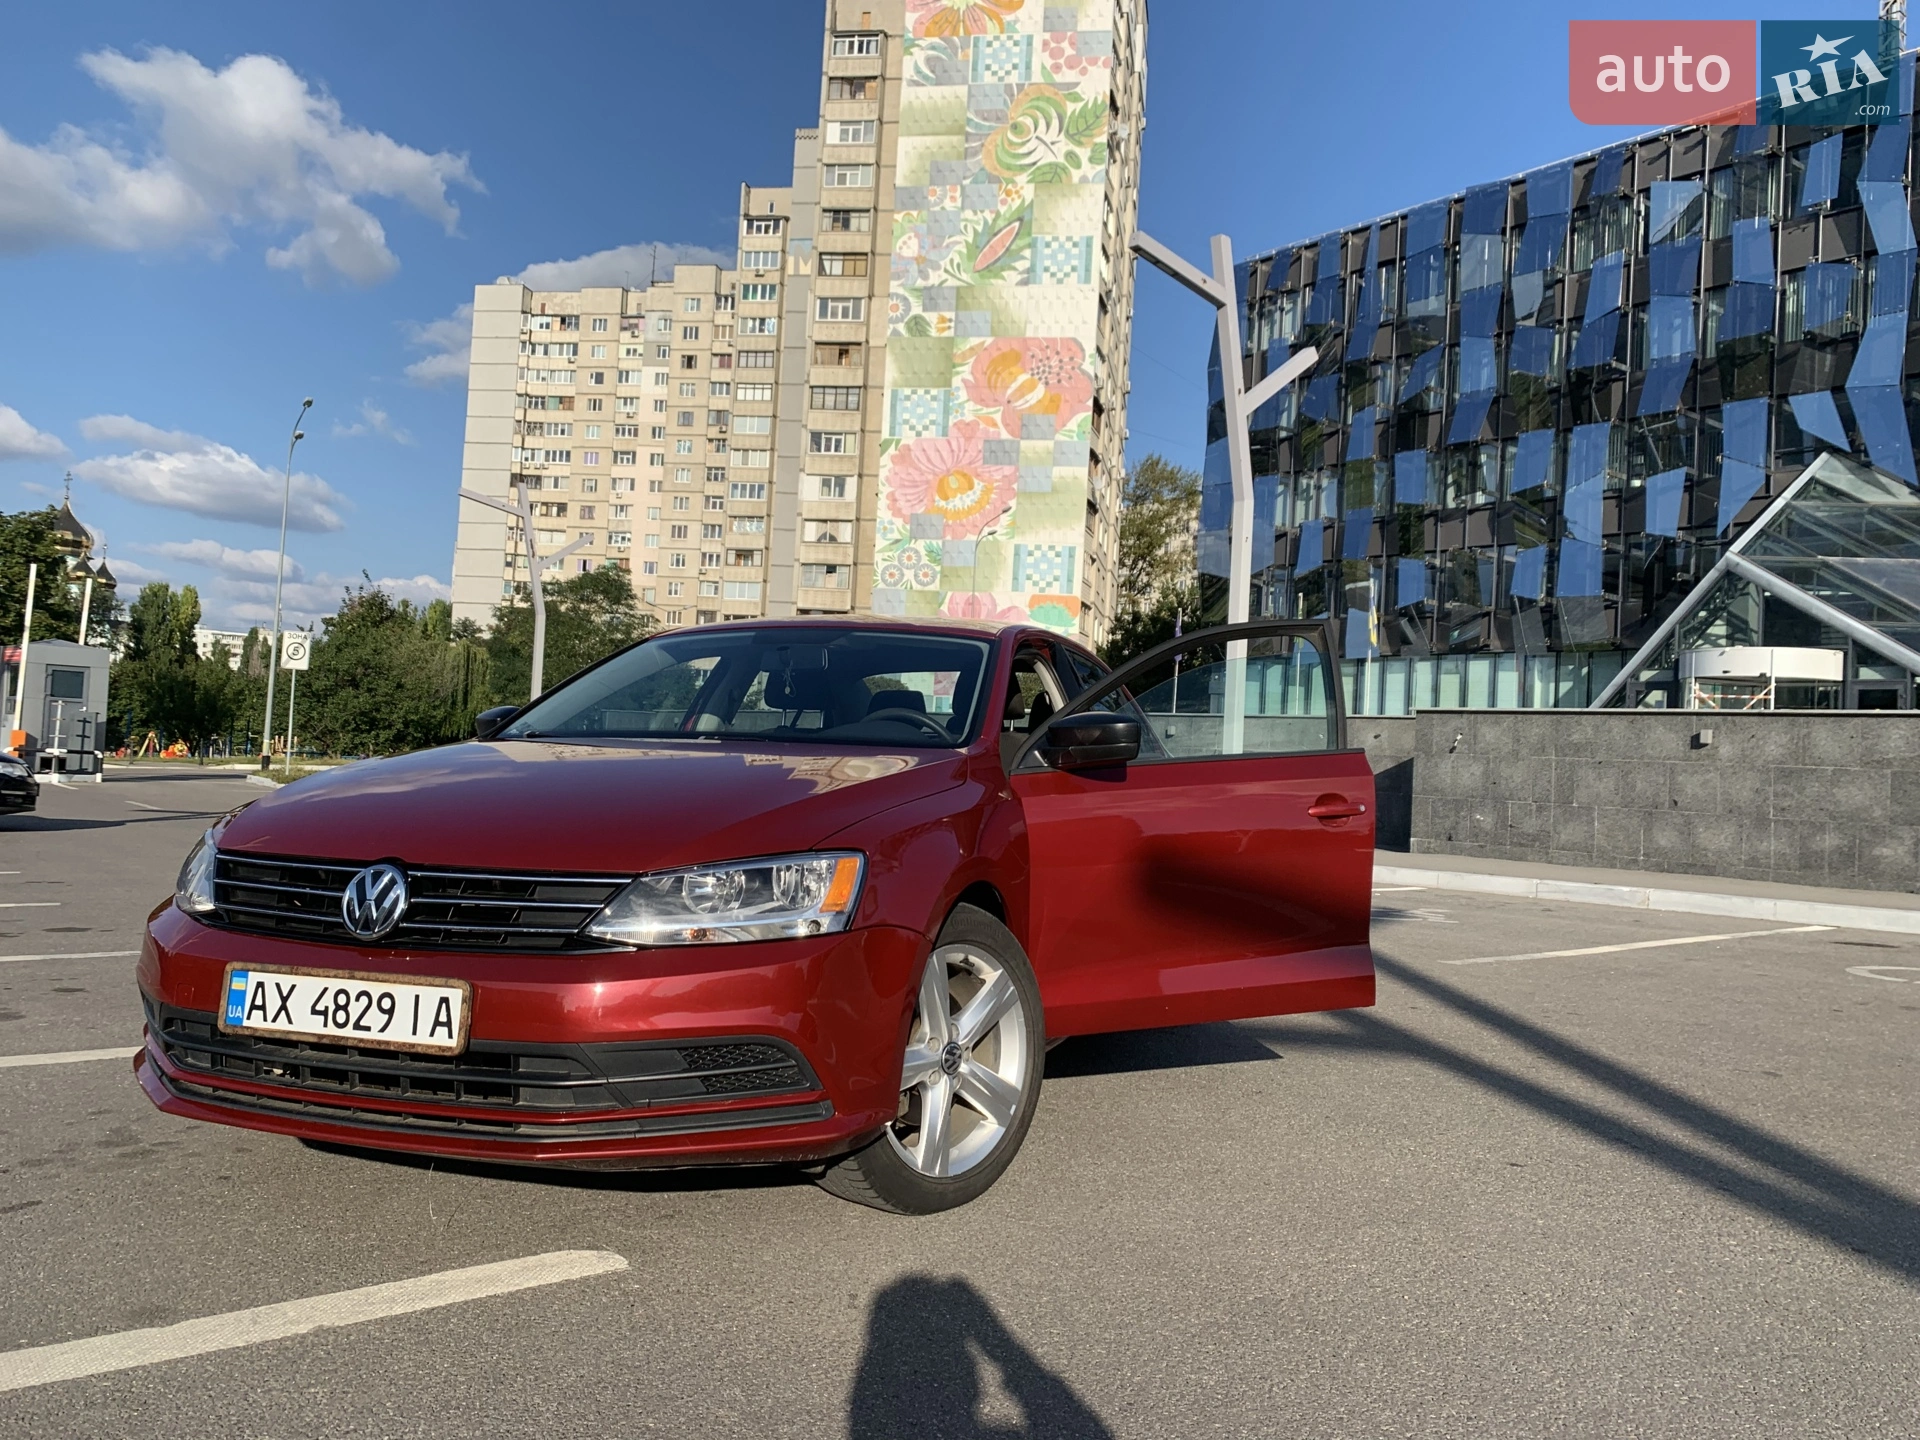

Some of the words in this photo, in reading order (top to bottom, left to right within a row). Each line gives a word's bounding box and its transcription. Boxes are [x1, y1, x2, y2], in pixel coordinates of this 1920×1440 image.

[288, 632, 308, 640] ЗОНА
[292, 646, 299, 656] 5
[228, 1005, 243, 1019] UA
[246, 981, 297, 1025] AX
[310, 986, 396, 1033] 4829
[411, 994, 453, 1039] IA
